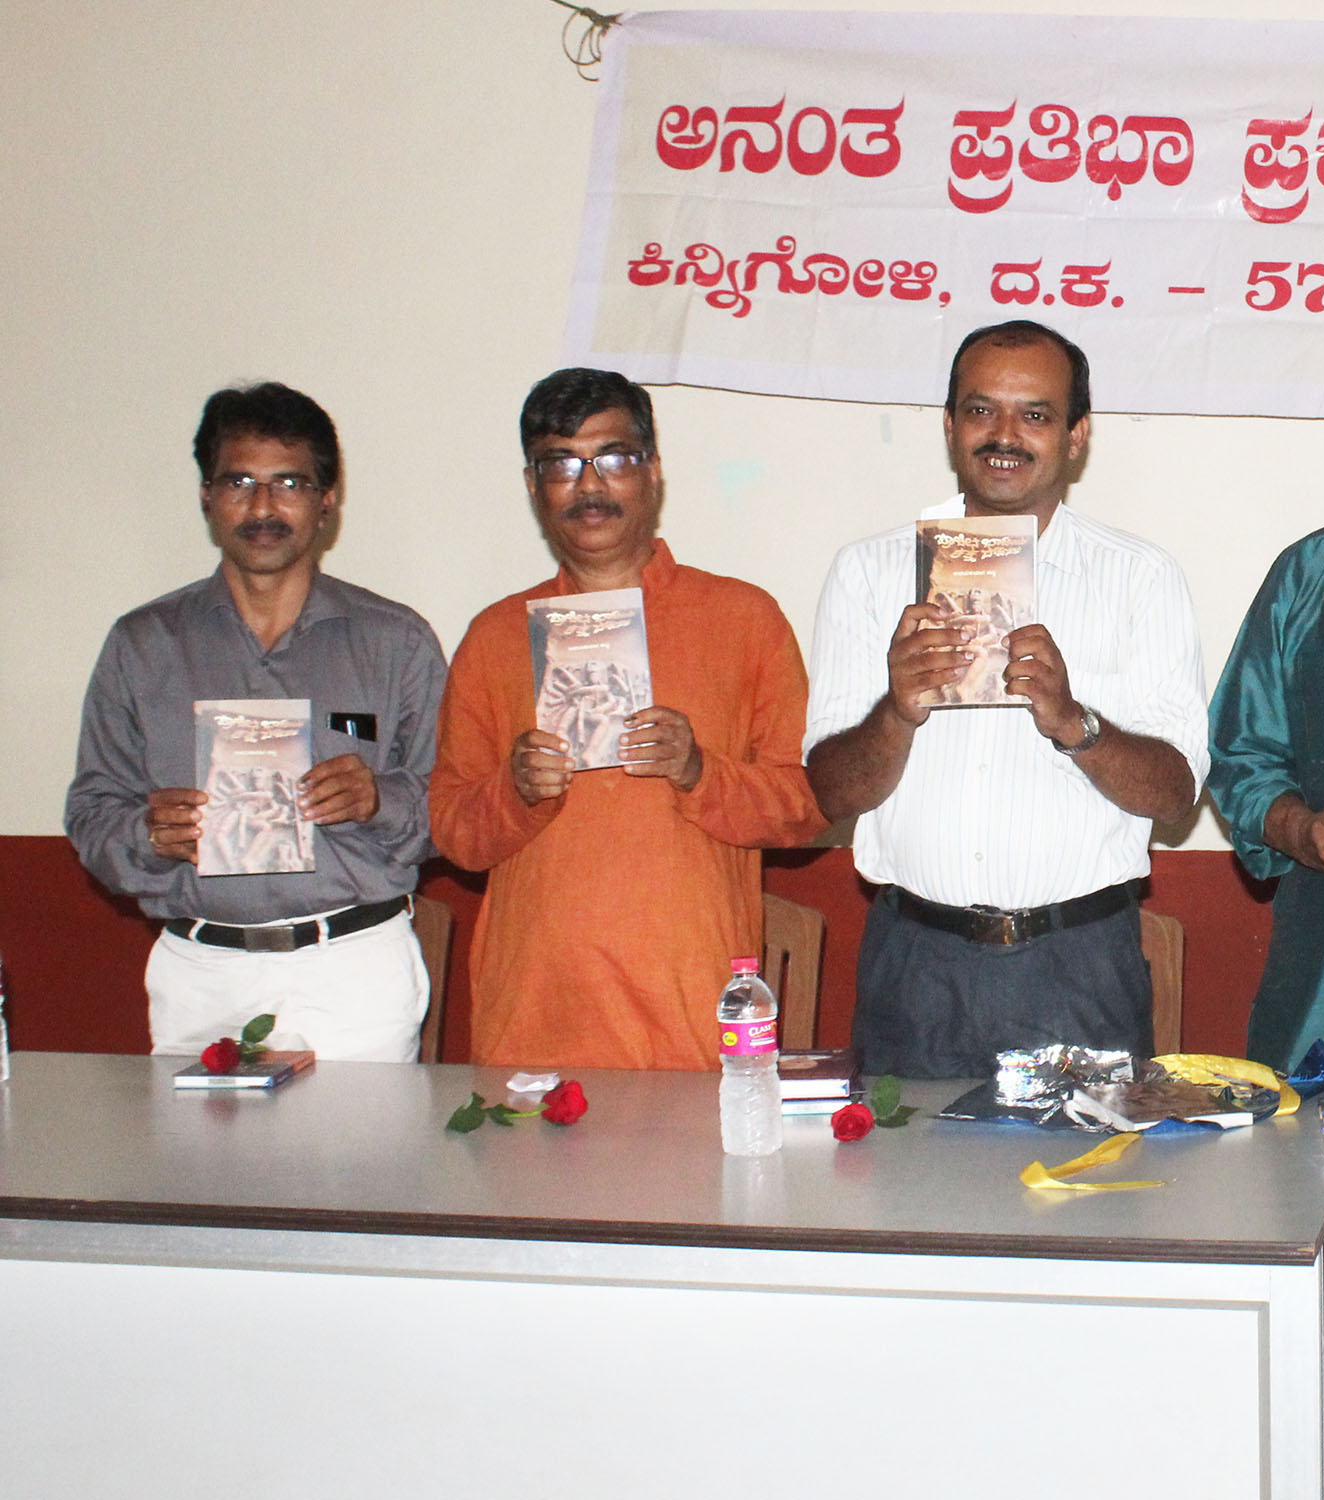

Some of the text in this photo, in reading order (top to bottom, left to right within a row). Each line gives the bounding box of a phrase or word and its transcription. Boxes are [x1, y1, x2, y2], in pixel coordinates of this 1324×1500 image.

[657, 94, 904, 178] ಅನಂತ
[948, 100, 1194, 213] ಪ್ರತಿಭಾ
[628, 236, 951, 318] ಕಿನ್ನಿಗೋಳಿ,
[991, 258, 1124, 308] ದ.ಕ.
